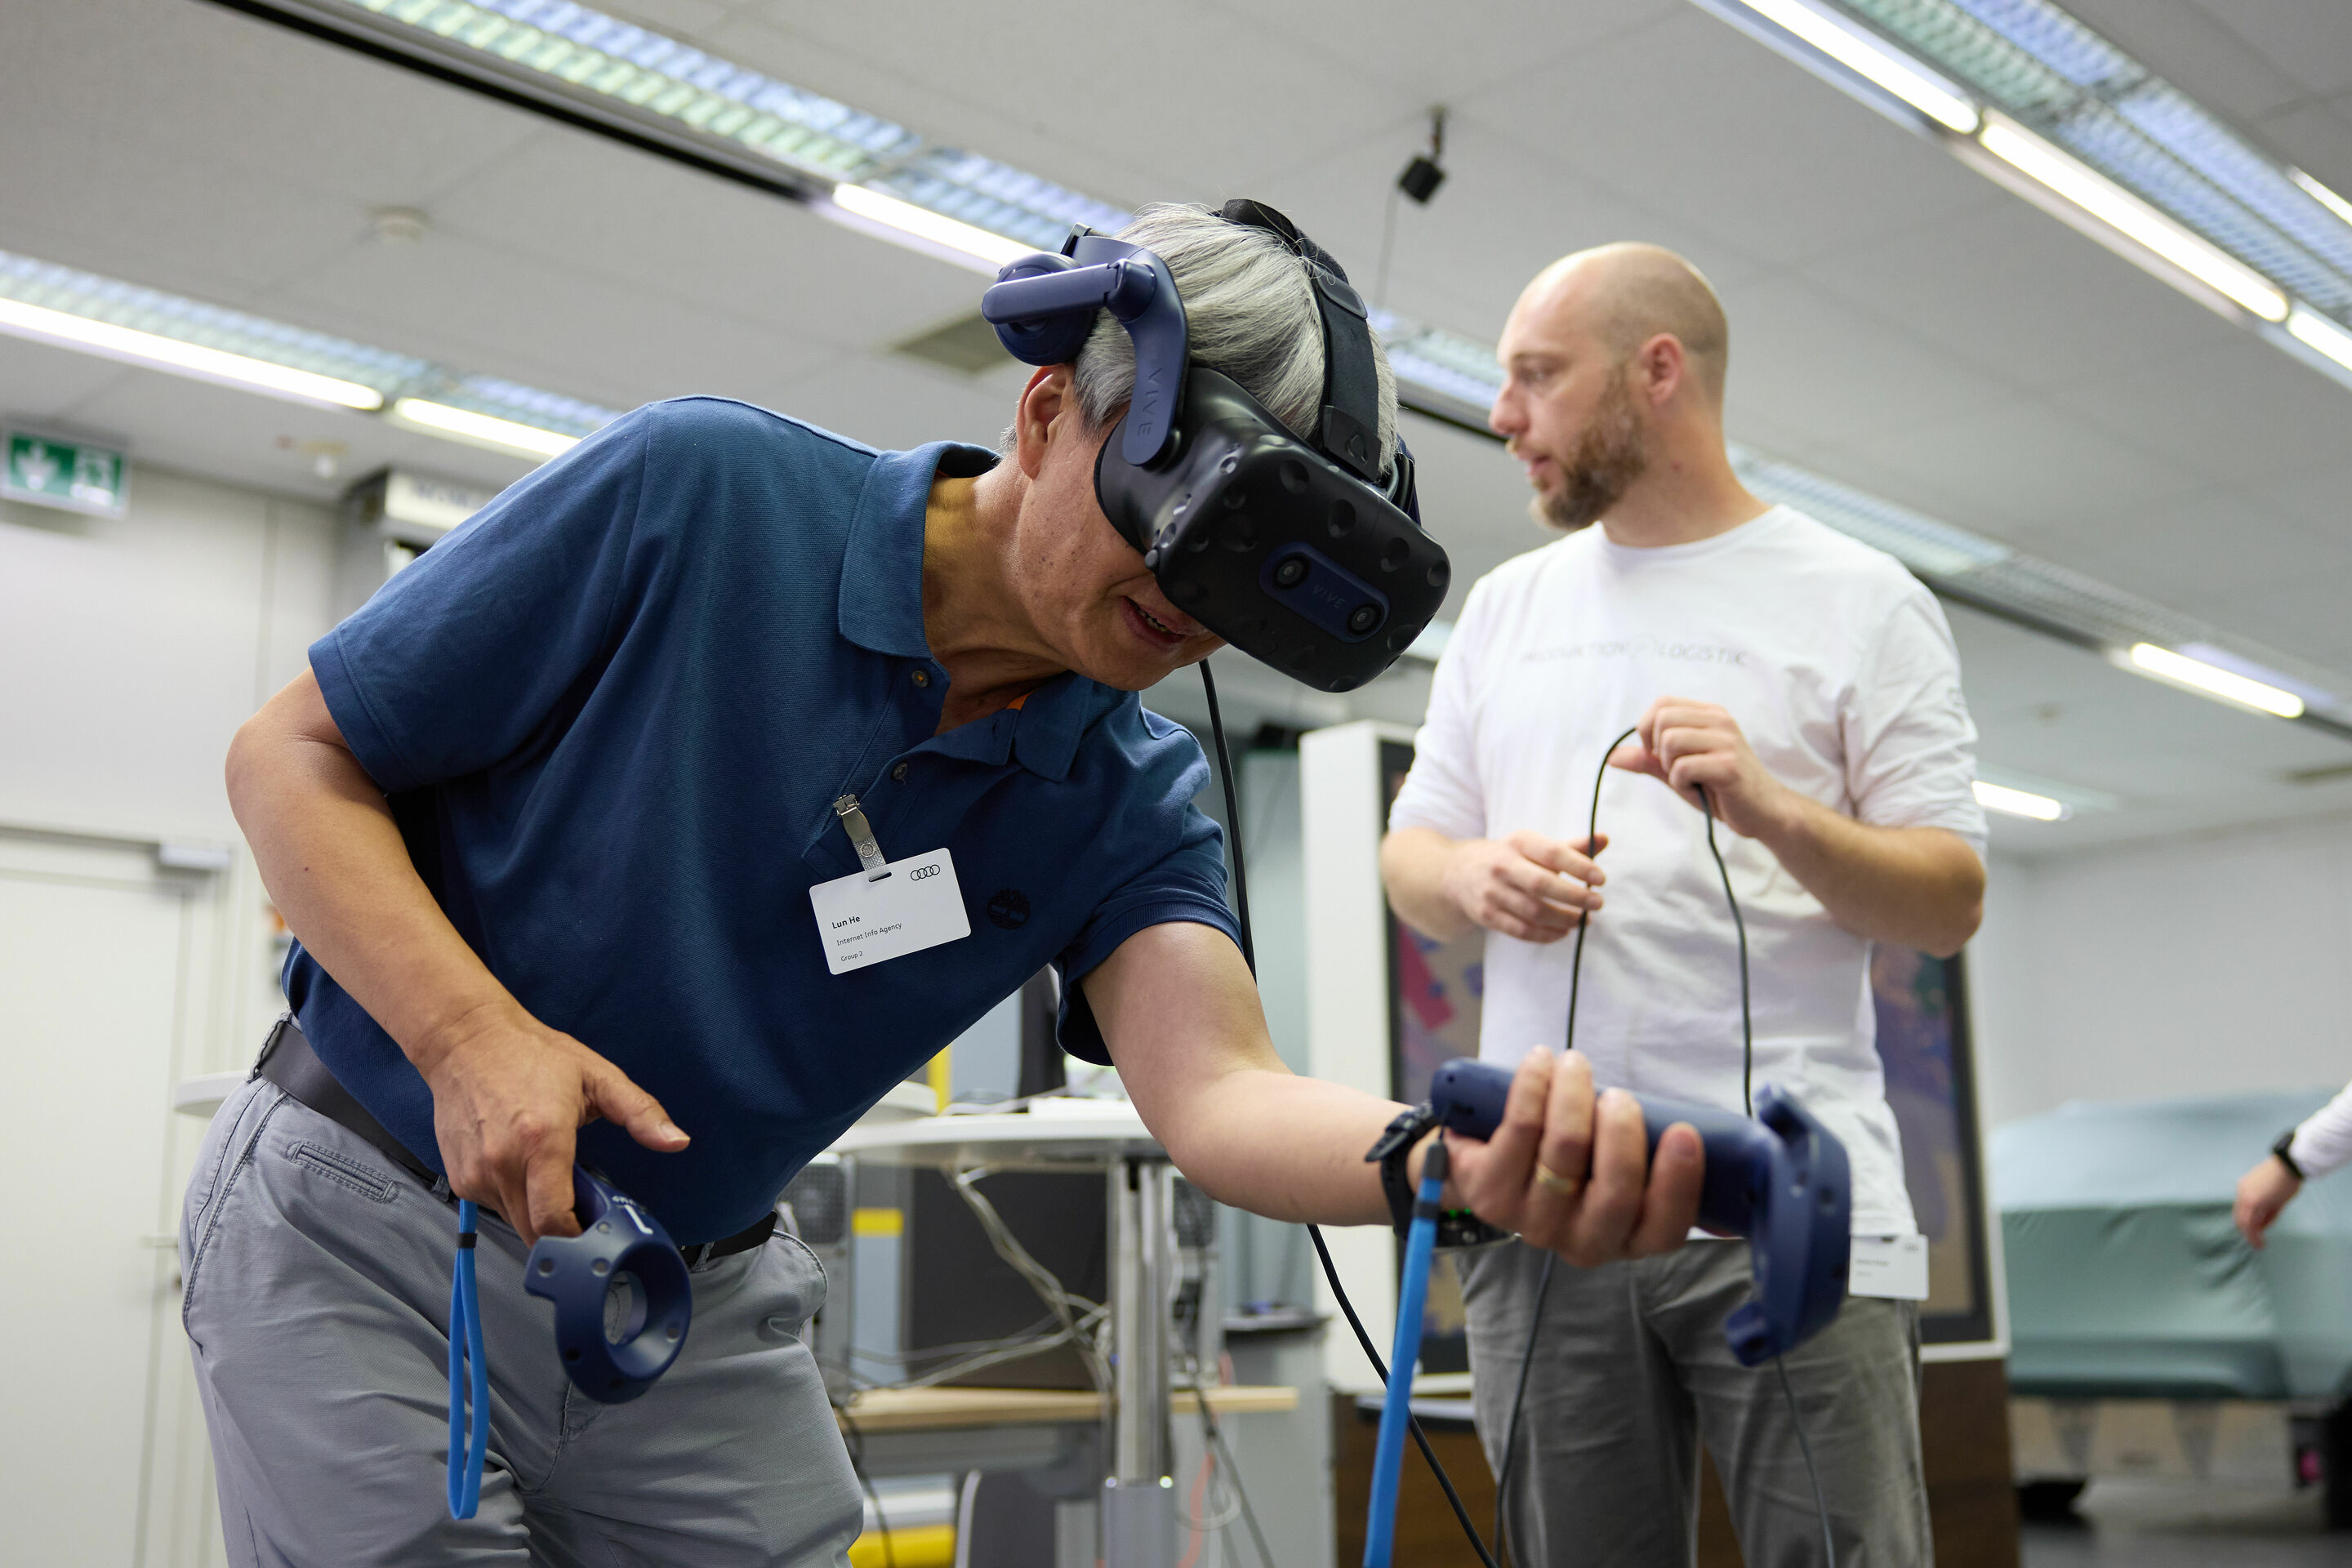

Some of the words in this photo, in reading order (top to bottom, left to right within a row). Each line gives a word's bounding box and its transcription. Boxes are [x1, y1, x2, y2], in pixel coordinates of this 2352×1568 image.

[1137, 368, 1163, 436] VIVE
[1312, 583, 1347, 609] VIVE
[831, 920, 848, 929] Lun
[849, 915, 861, 924] He
[836, 933, 864, 946] Internet
[864, 929, 879, 938] Info
[879, 923, 902, 933] Agency
[840, 953, 858, 962] Group
